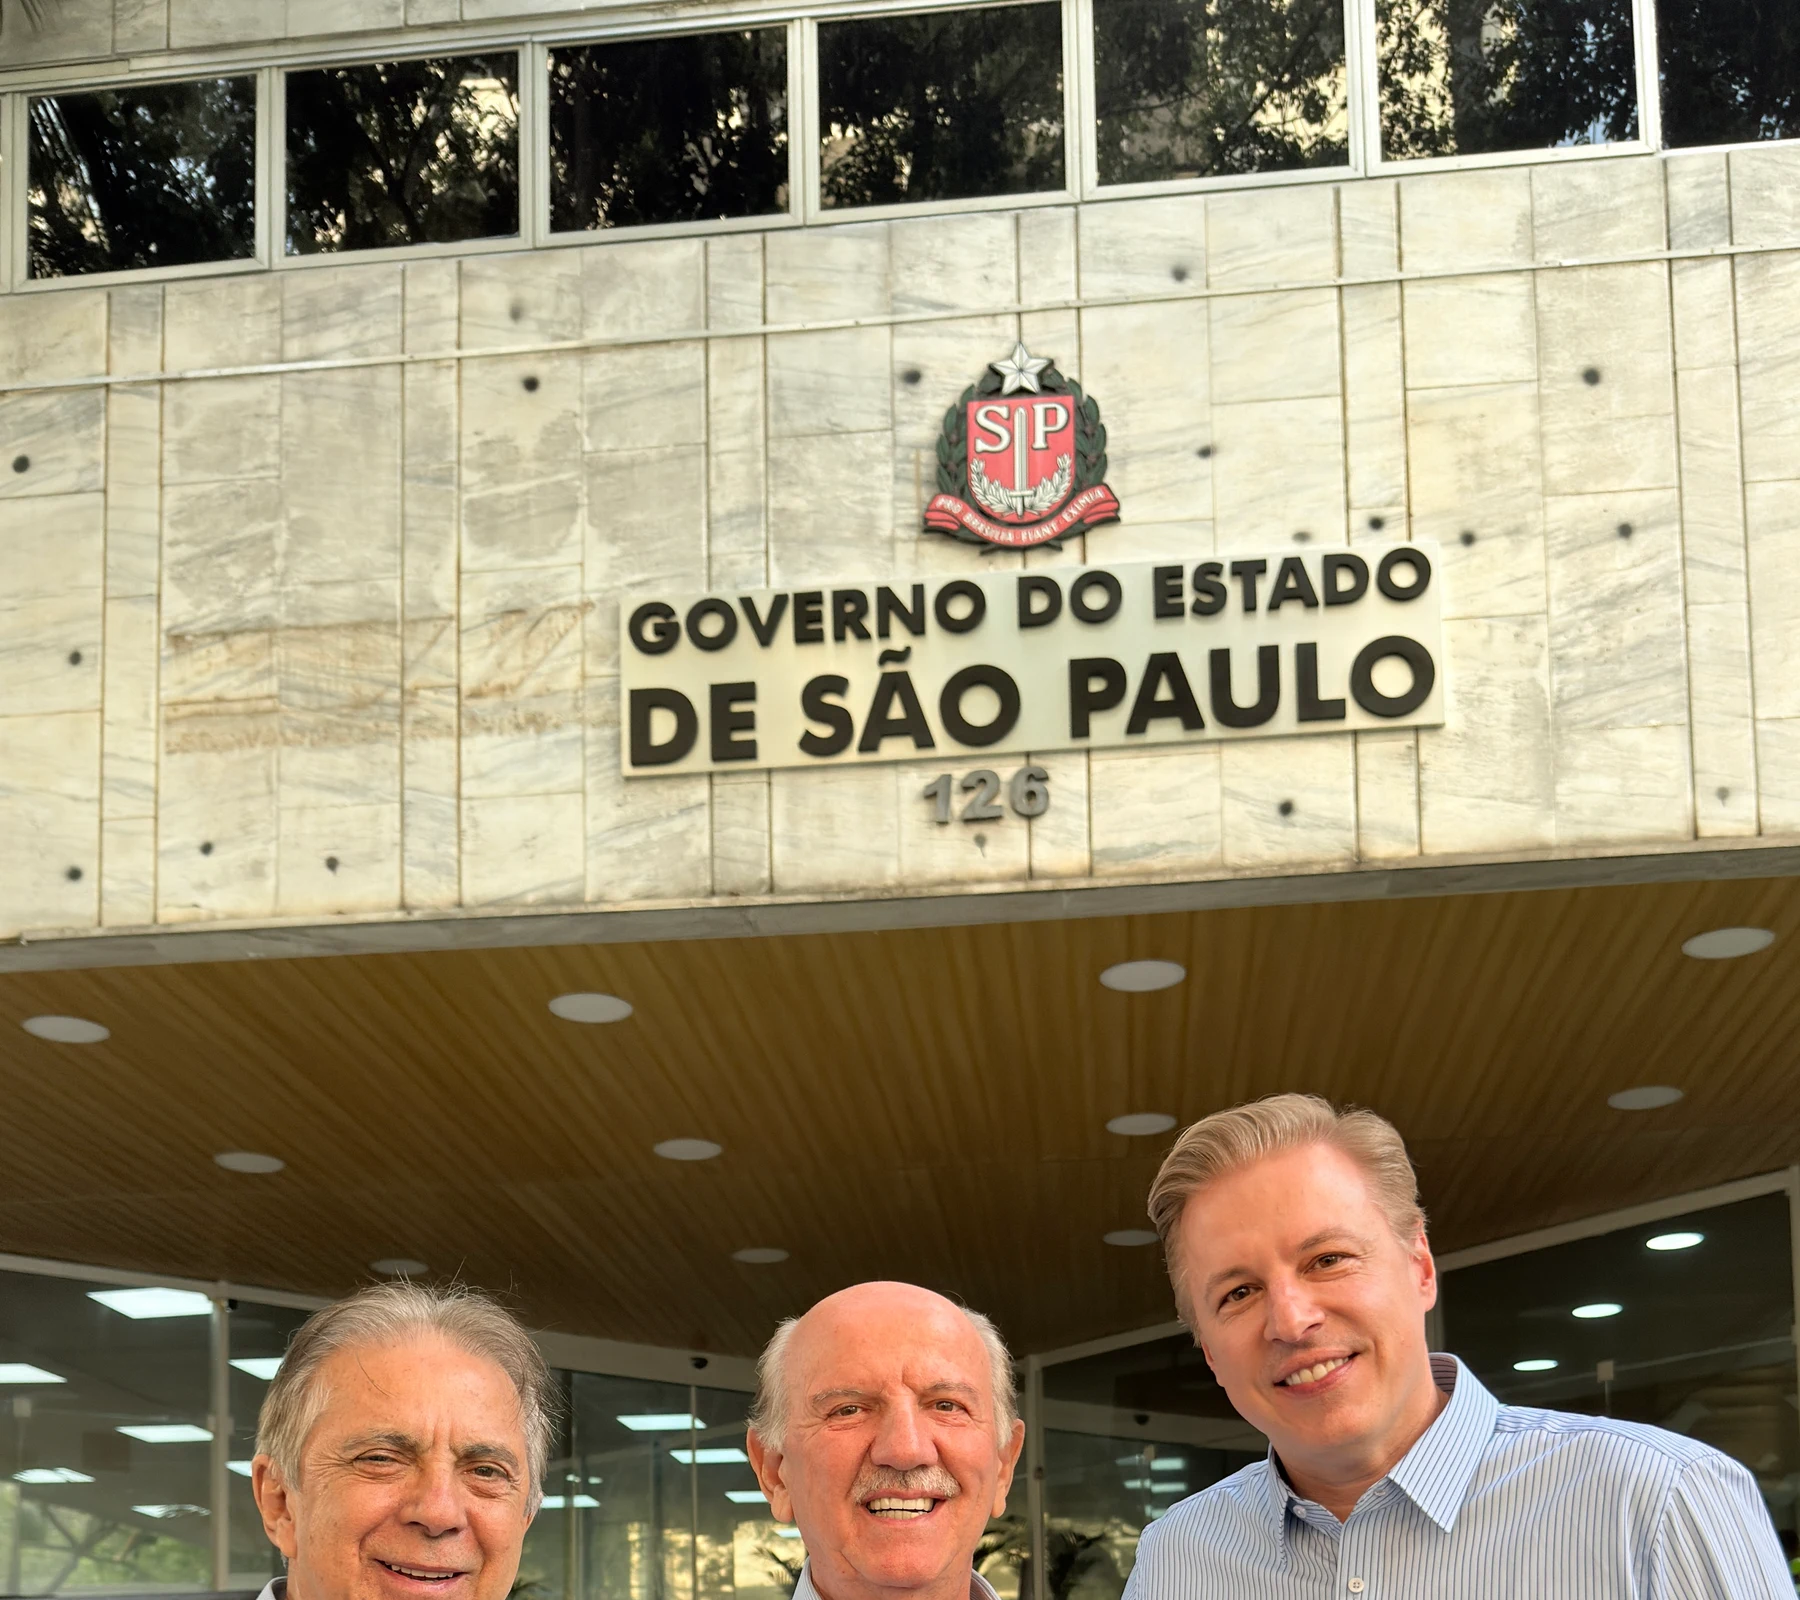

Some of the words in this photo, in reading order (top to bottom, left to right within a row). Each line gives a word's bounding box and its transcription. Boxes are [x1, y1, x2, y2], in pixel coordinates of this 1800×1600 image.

[628, 580, 986, 655] GOVERNO
[1017, 570, 1123, 629] DO
[1153, 547, 1431, 619] ESTADO
[629, 681, 757, 767] DE
[797, 645, 1021, 757] SÃO
[1069, 635, 1435, 739] PAULO
[923, 765, 1049, 825] 126
